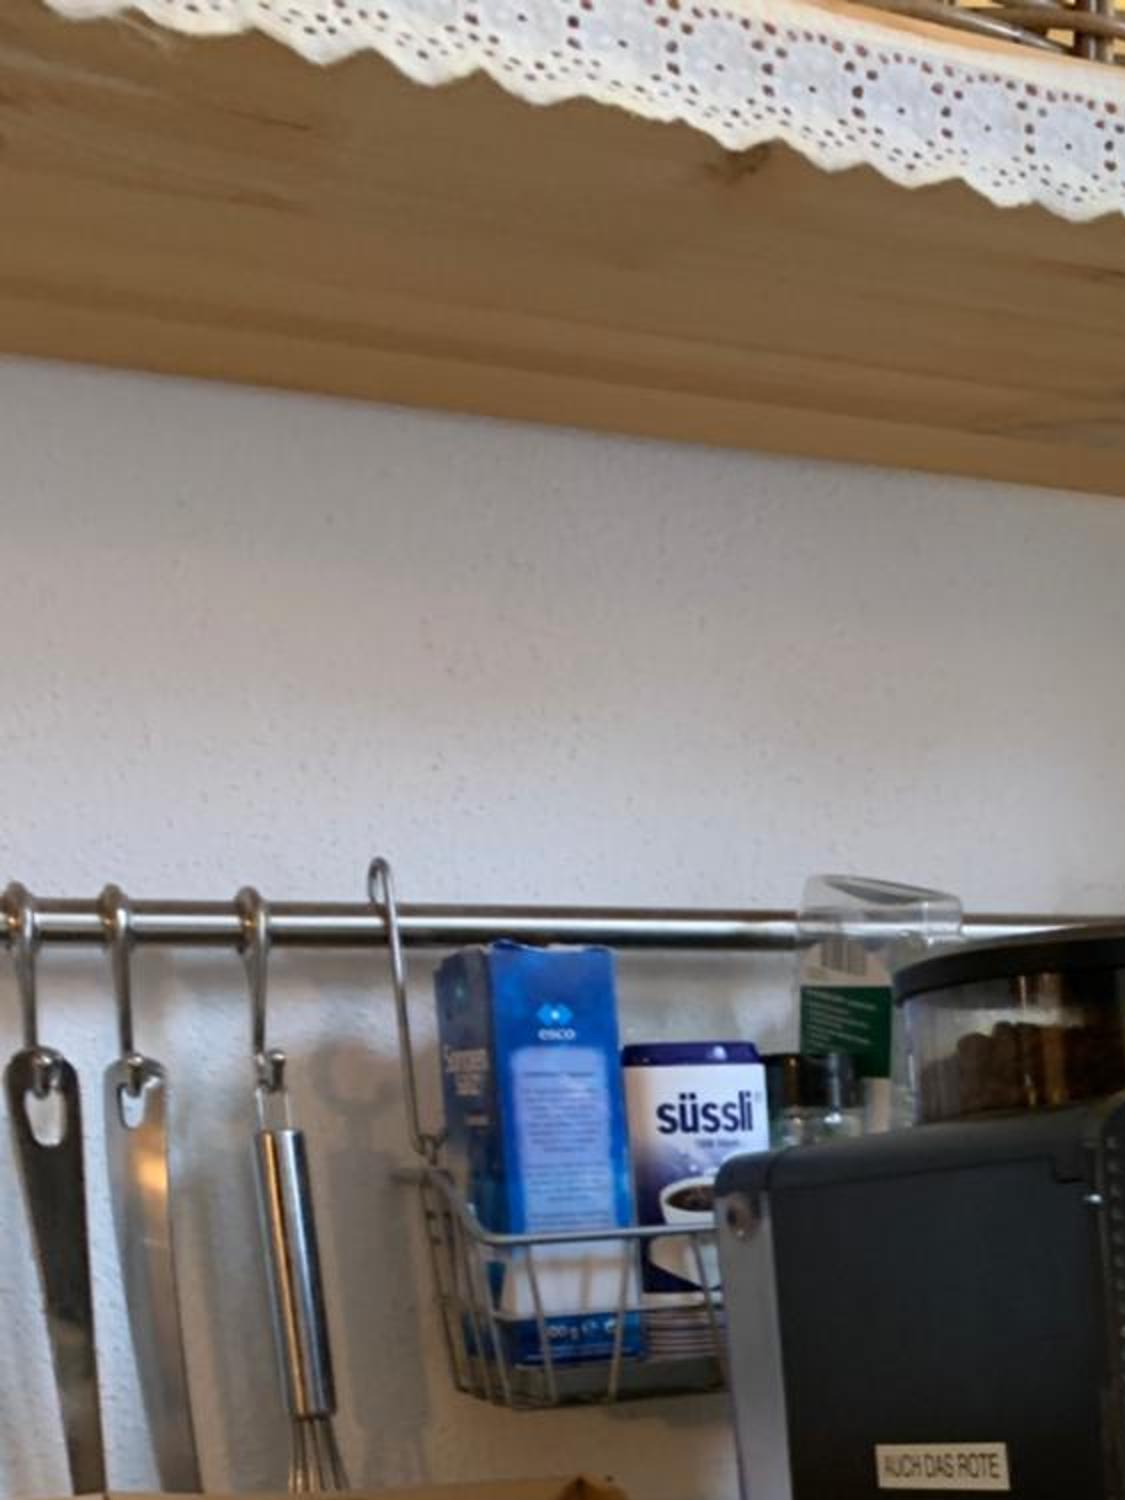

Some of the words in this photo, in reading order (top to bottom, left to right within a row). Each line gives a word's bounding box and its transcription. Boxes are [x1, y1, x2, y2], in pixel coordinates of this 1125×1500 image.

[656, 1090, 753, 1135] süssli
[924, 1453, 954, 1479] DAS
[957, 1452, 1001, 1479] ROTE
